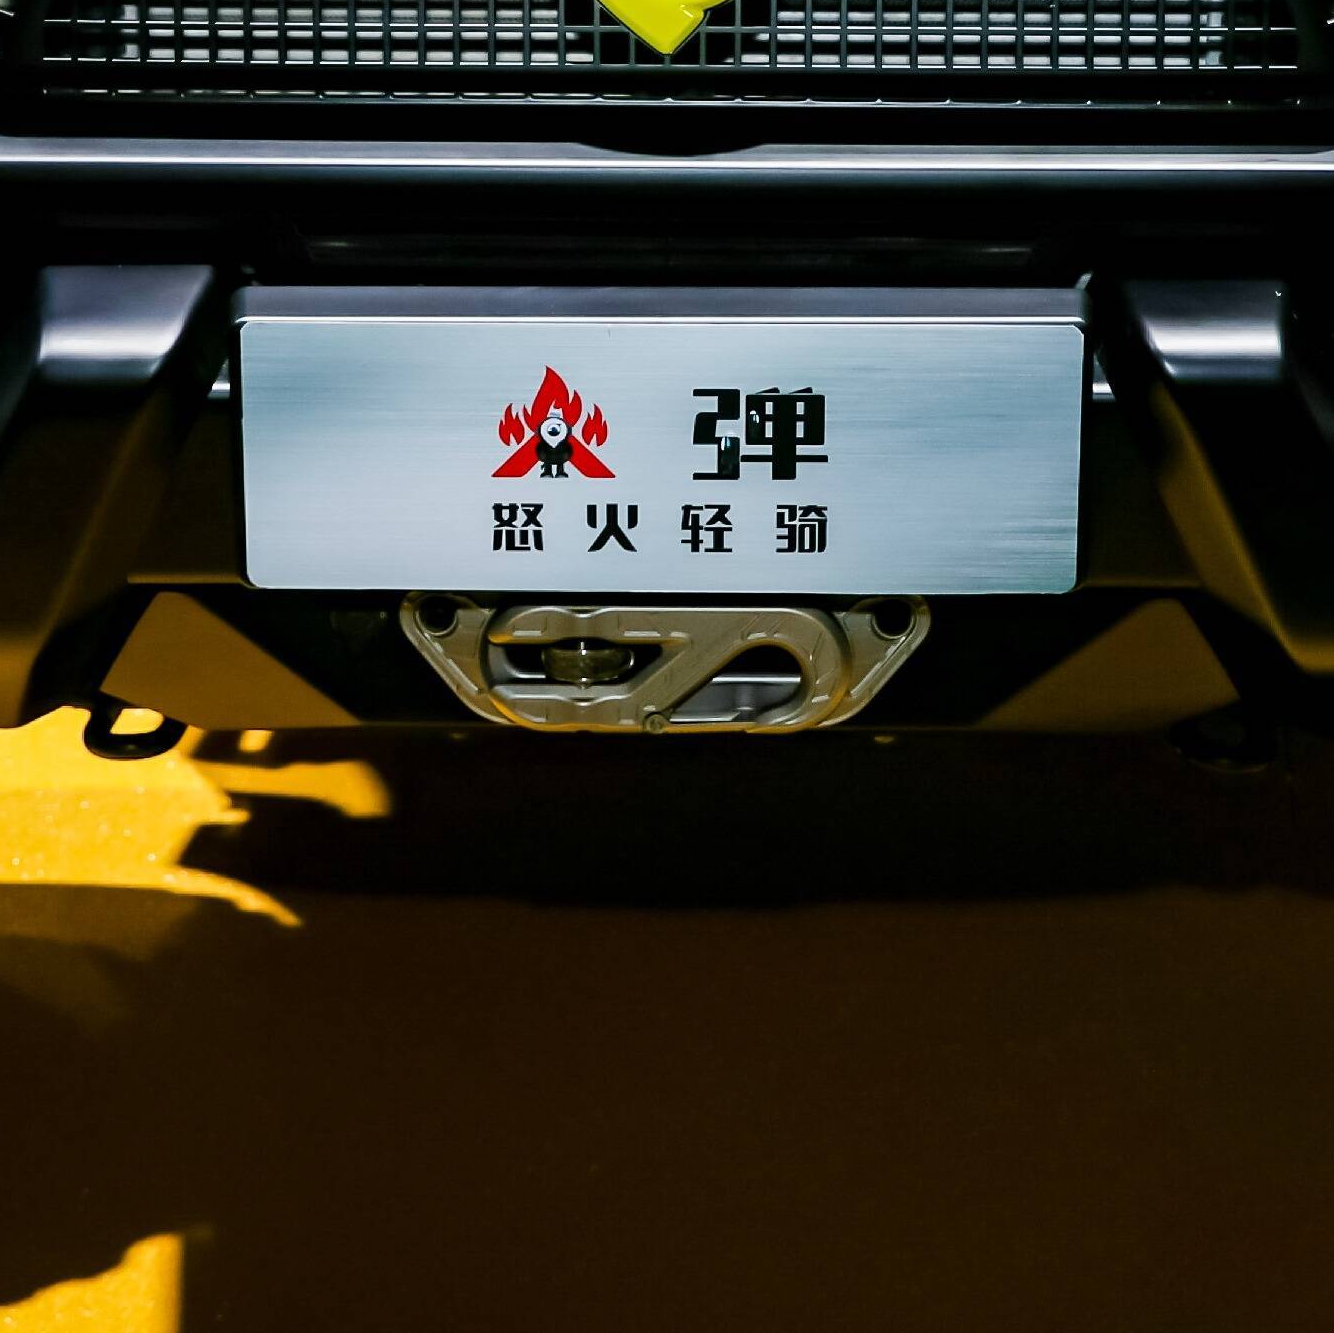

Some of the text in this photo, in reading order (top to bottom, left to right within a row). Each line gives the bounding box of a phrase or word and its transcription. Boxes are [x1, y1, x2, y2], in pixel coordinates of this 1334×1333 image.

[692, 386, 829, 480] 弹
[492, 502, 828, 553] 怒火轻骑
